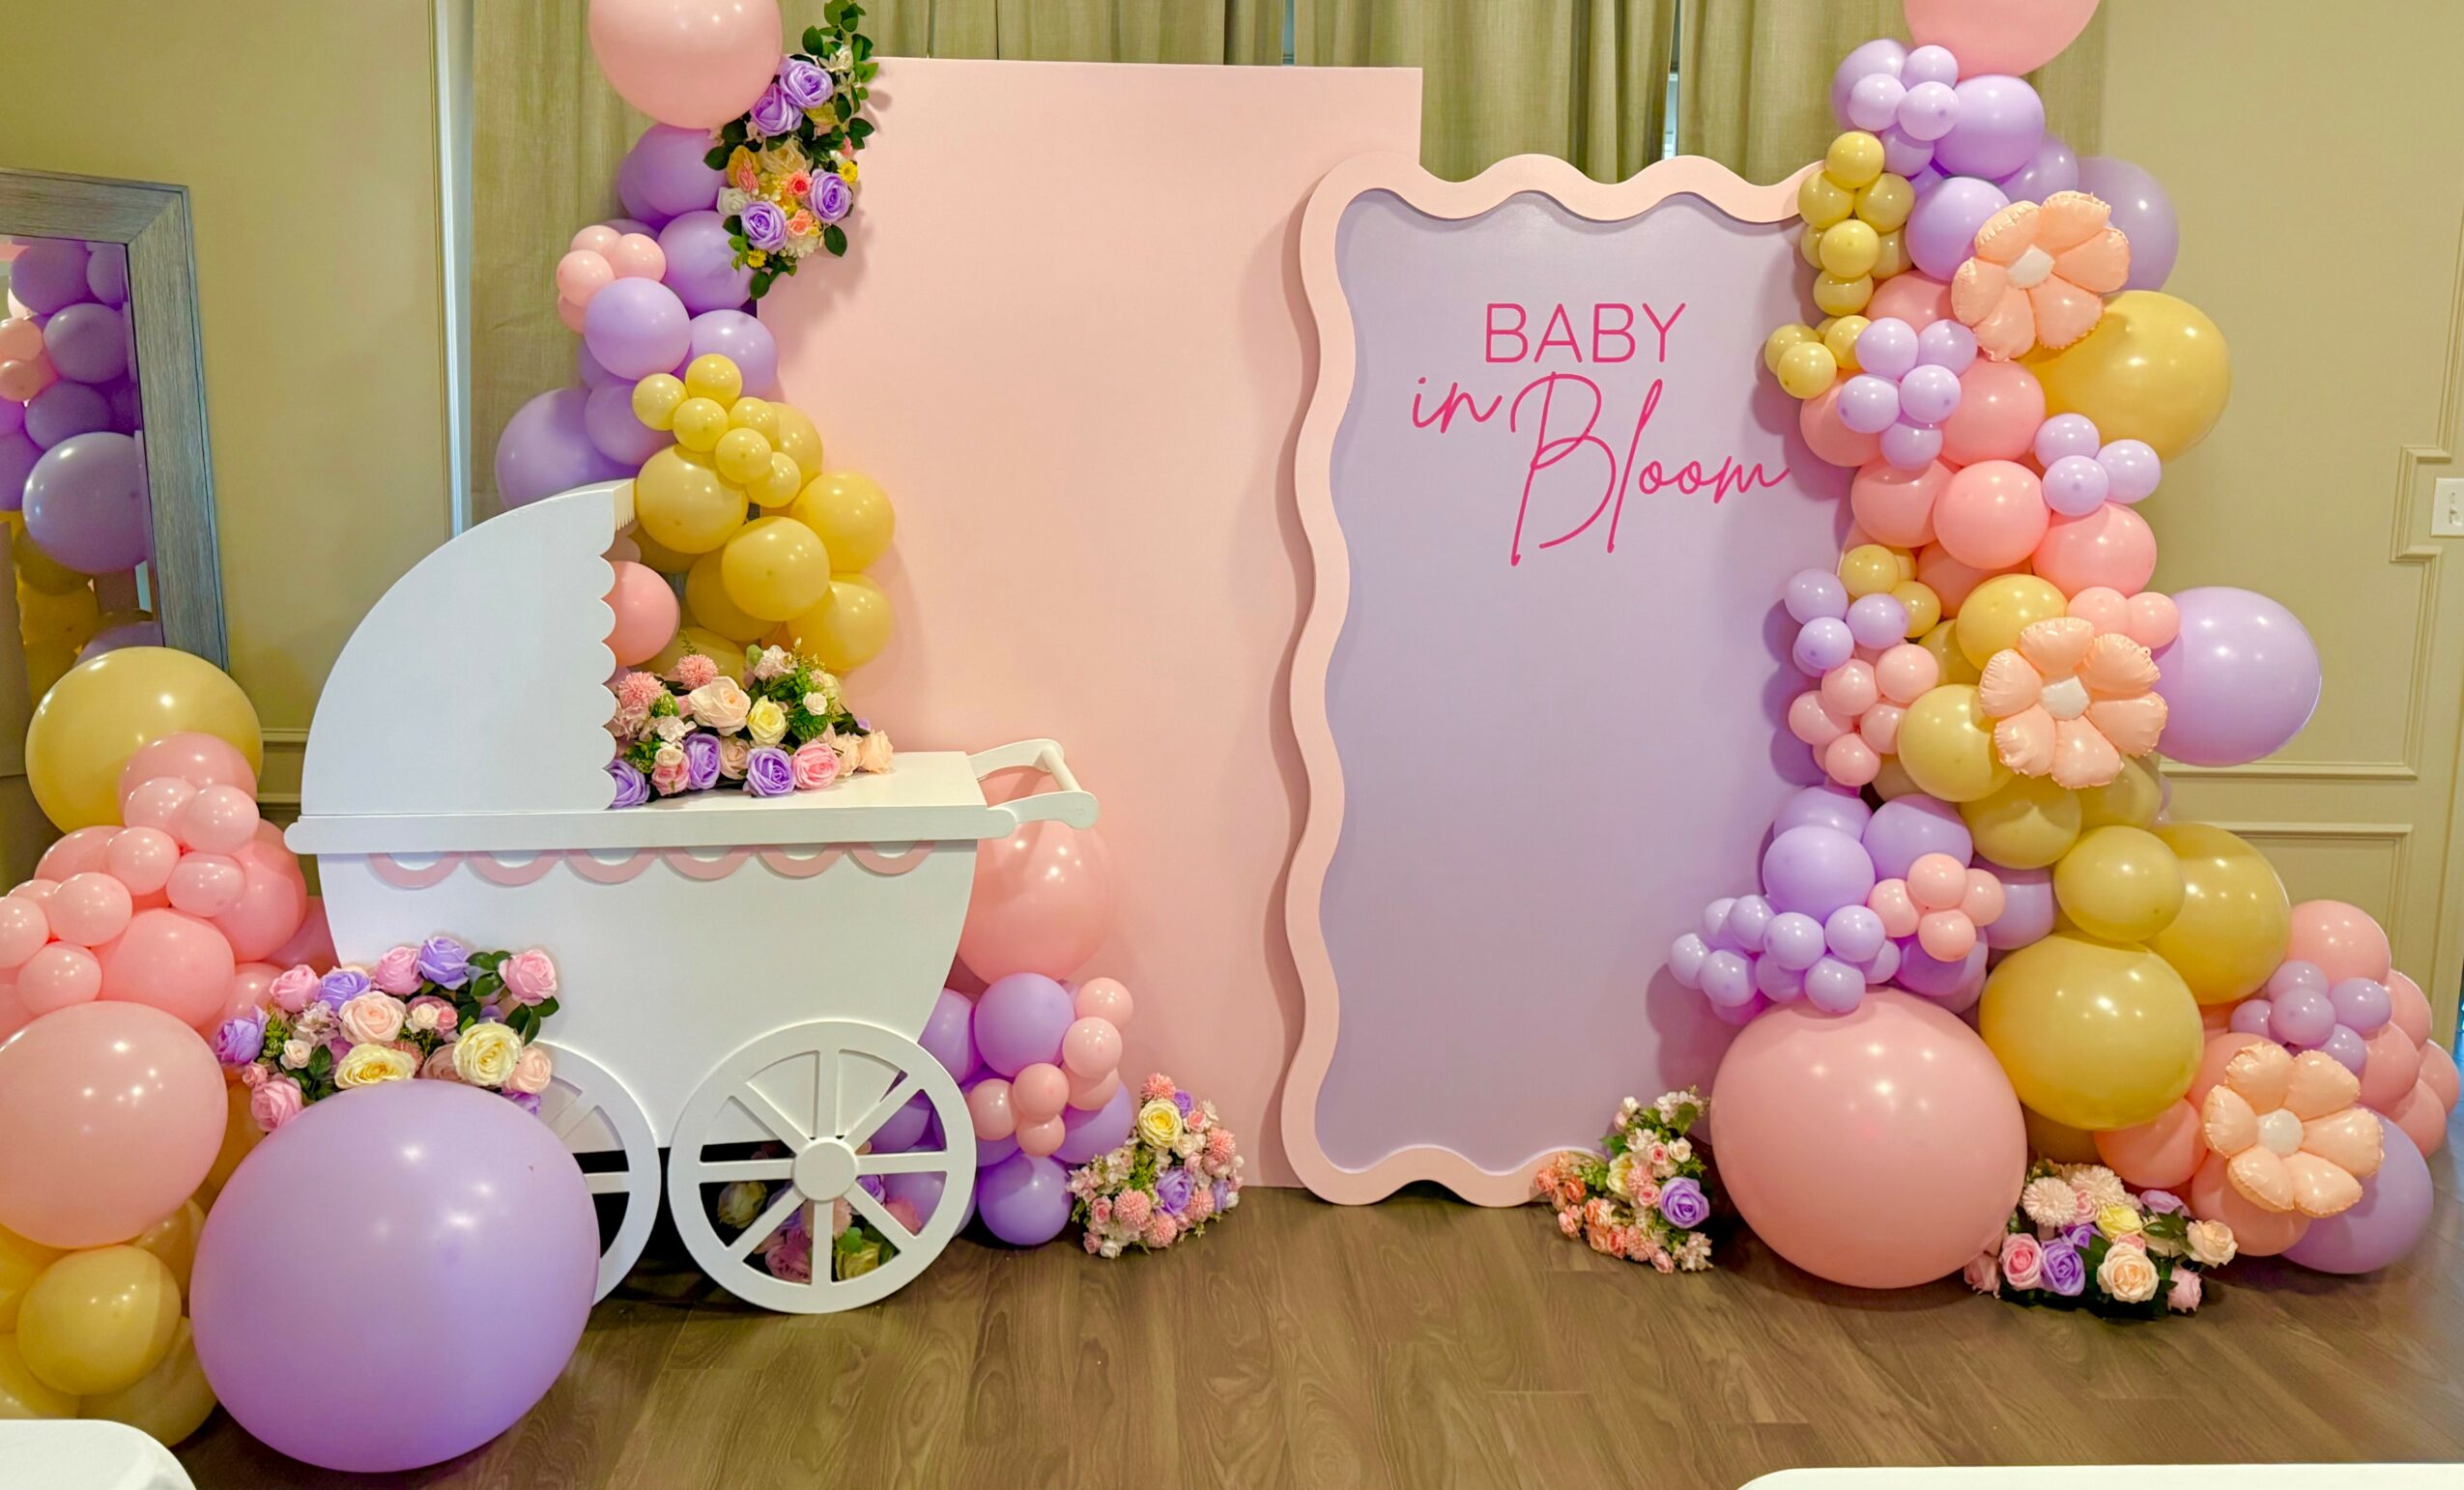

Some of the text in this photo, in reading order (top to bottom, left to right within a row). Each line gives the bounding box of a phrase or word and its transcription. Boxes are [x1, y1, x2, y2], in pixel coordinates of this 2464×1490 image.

[1485, 302, 1686, 364] BABY
[1412, 371, 1791, 567] in Bloom
